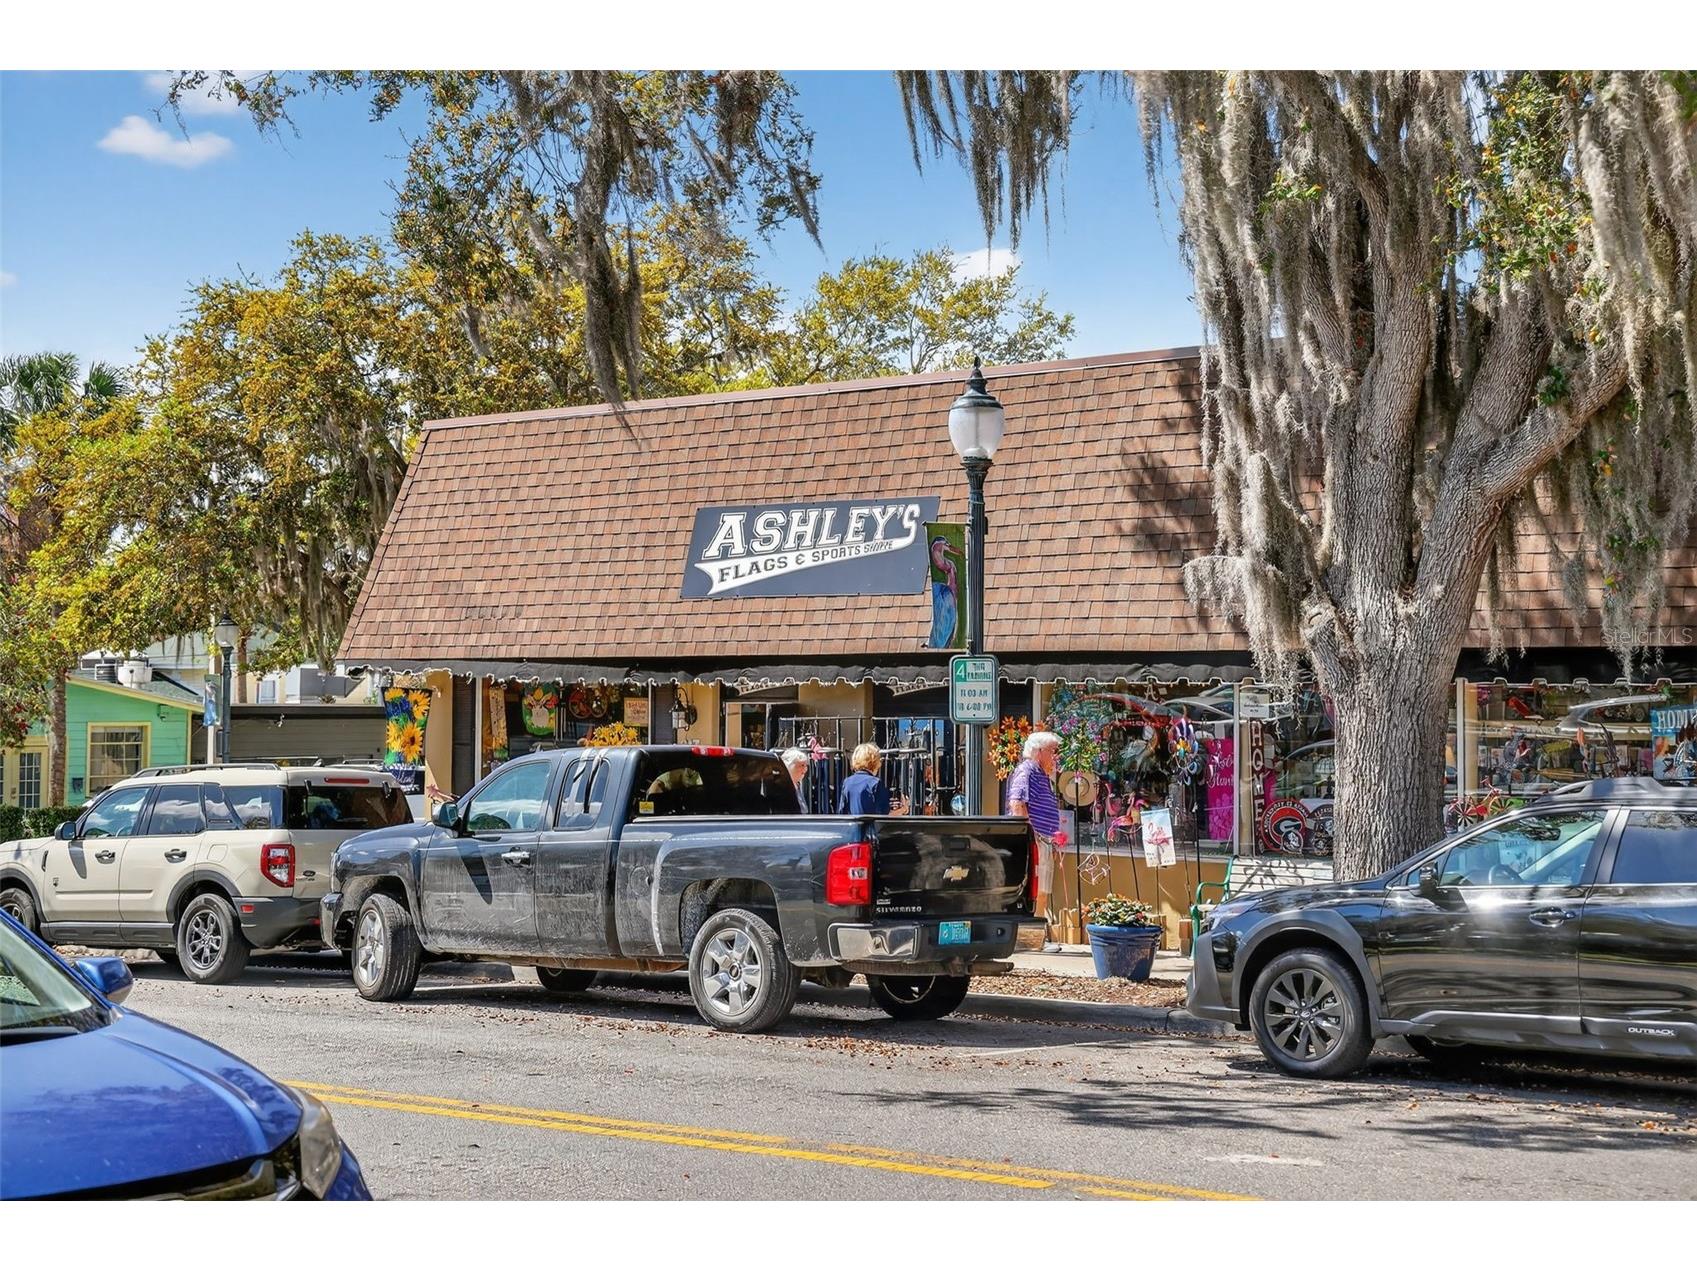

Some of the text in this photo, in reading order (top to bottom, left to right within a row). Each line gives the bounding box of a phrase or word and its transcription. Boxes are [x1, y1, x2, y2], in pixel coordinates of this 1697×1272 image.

[702, 504, 920, 559] ASHLEY'S
[718, 555, 788, 583] FLAGS
[812, 545, 861, 563] SPORTS
[956, 664, 965, 679] 4
[979, 689, 988, 697] AM
[1627, 1026, 1676, 1037] OUTBACK
